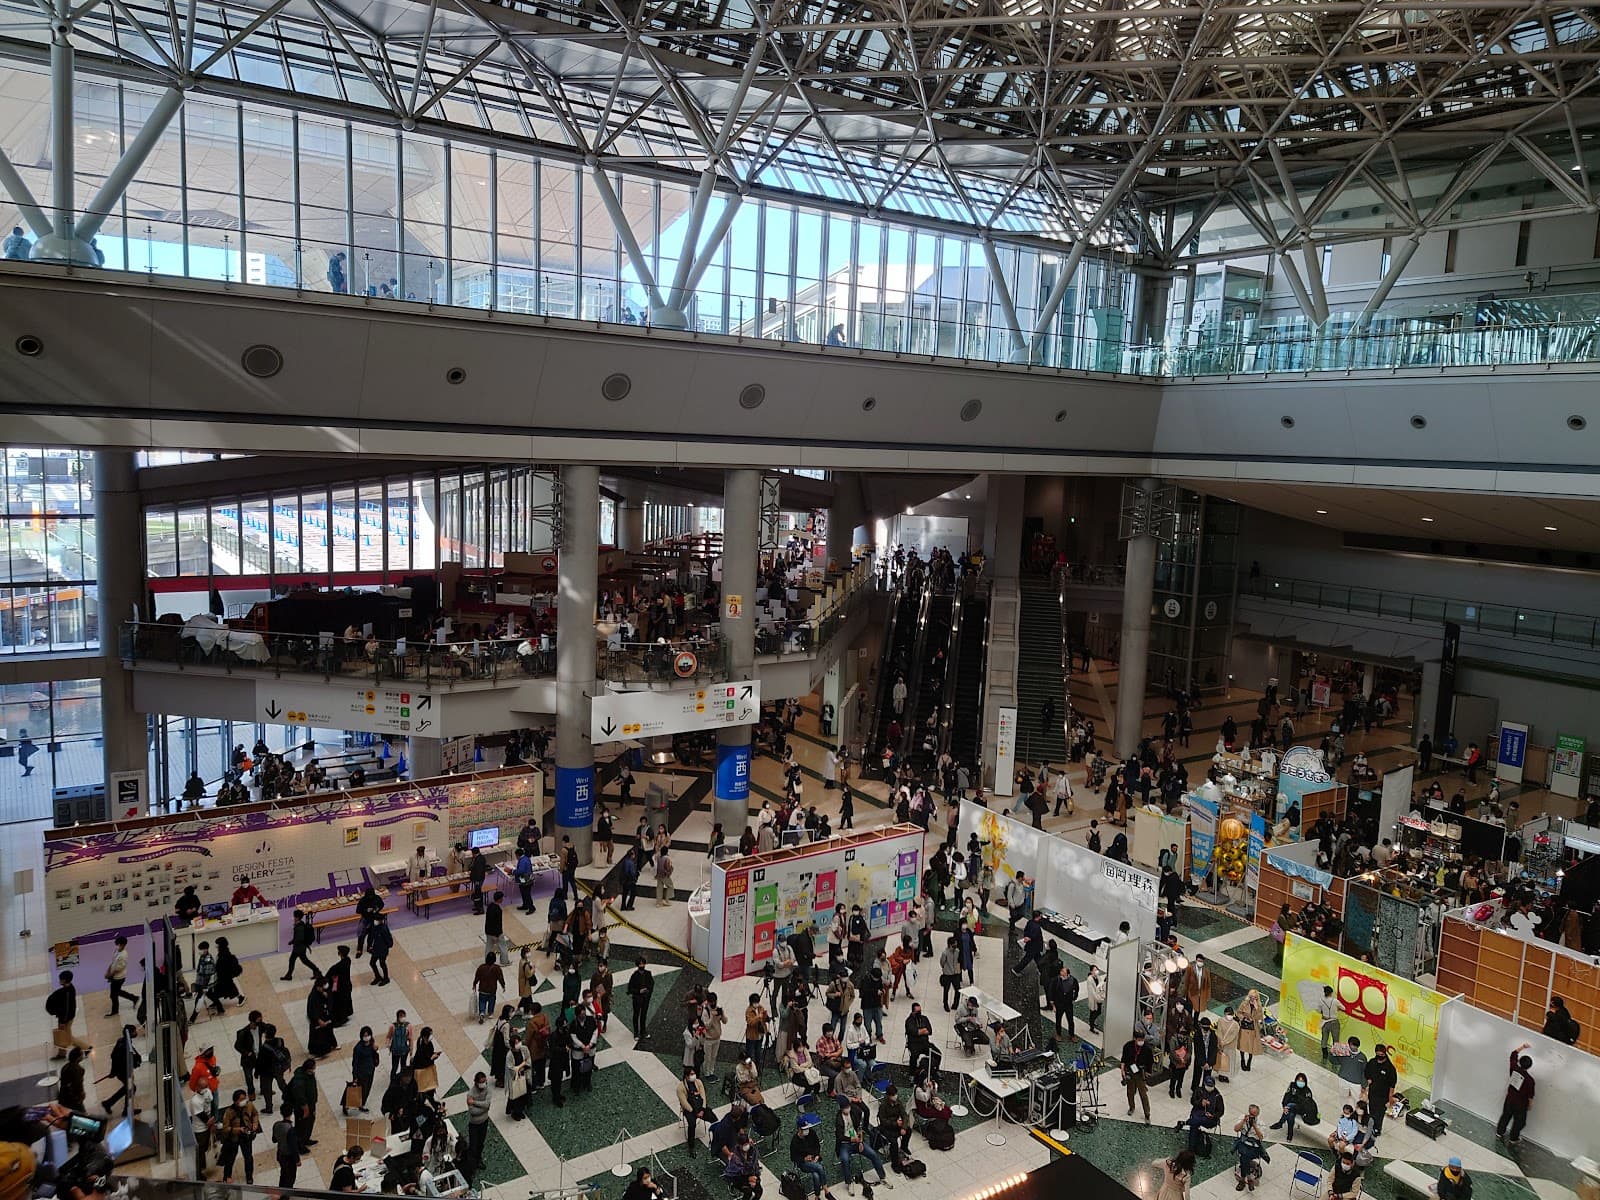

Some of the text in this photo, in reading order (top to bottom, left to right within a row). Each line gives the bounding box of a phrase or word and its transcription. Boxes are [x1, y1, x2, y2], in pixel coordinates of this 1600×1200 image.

[736, 760, 747, 777] 西
[576, 784, 588, 802] 西
[845, 850, 855, 861] 4F
[232, 861, 265, 874] DESIGN
[268, 856, 295, 868] FESTA
[232, 868, 275, 882] GALLERY
[755, 869, 764, 881] 1F
[728, 878, 747, 888] AREA
[728, 885, 746, 896] MAP
